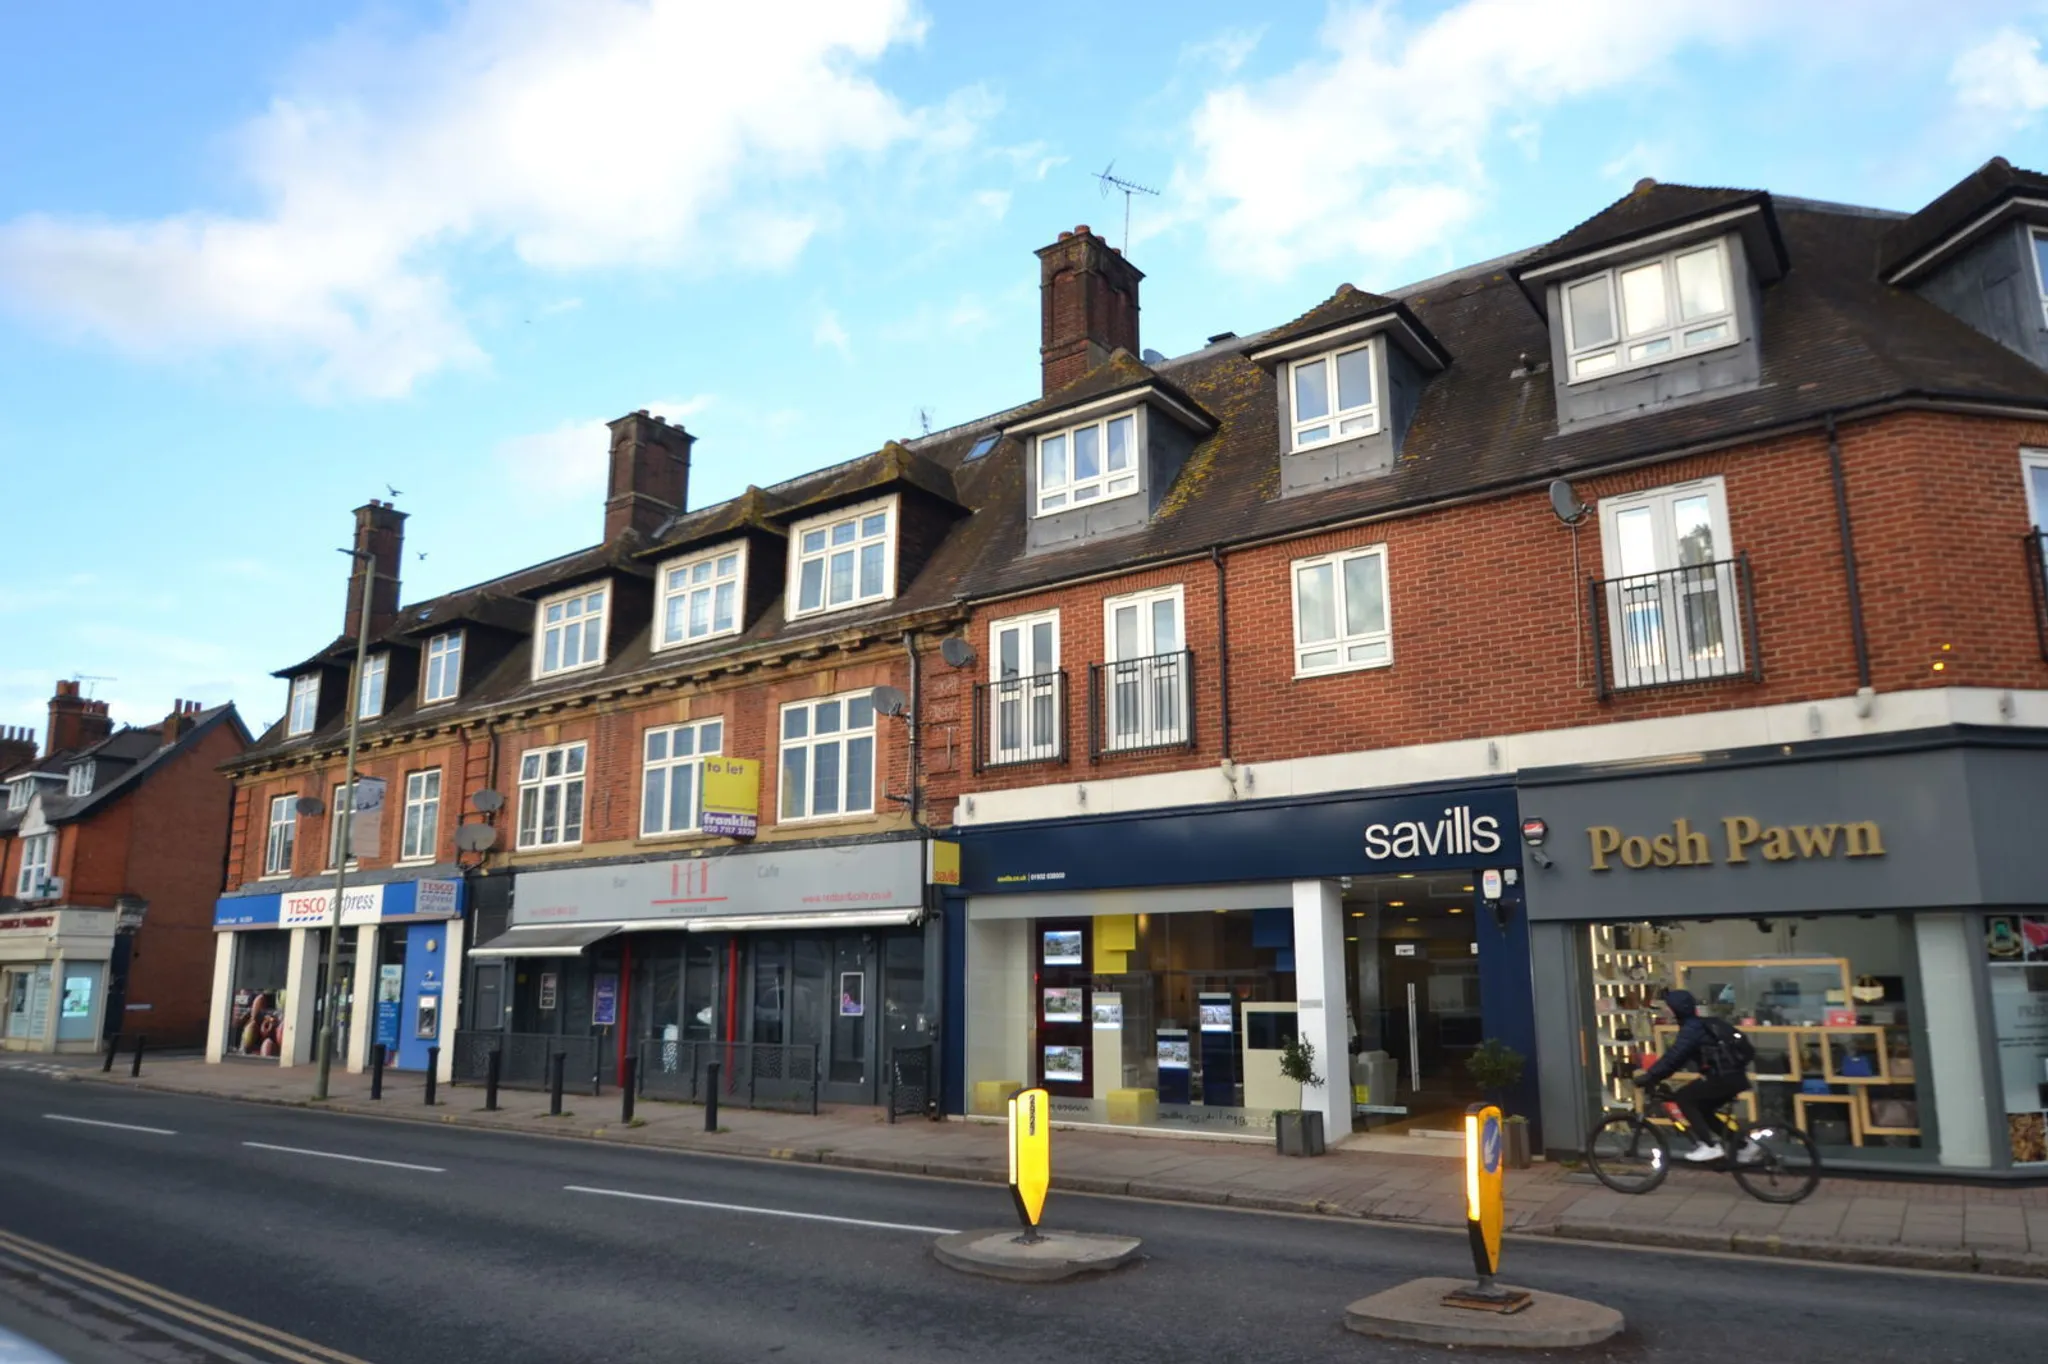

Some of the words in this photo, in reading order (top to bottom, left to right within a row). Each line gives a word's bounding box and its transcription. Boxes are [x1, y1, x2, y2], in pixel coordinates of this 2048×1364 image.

[707, 762, 721, 774] to
[726, 760, 744, 775] let
[704, 813, 756, 827] franklin
[1365, 806, 1501, 860] savills
[1585, 817, 1713, 871] Posh
[1720, 815, 1887, 863] Pawn
[288, 896, 326, 915] TESCO
[329, 894, 374, 917] epress
